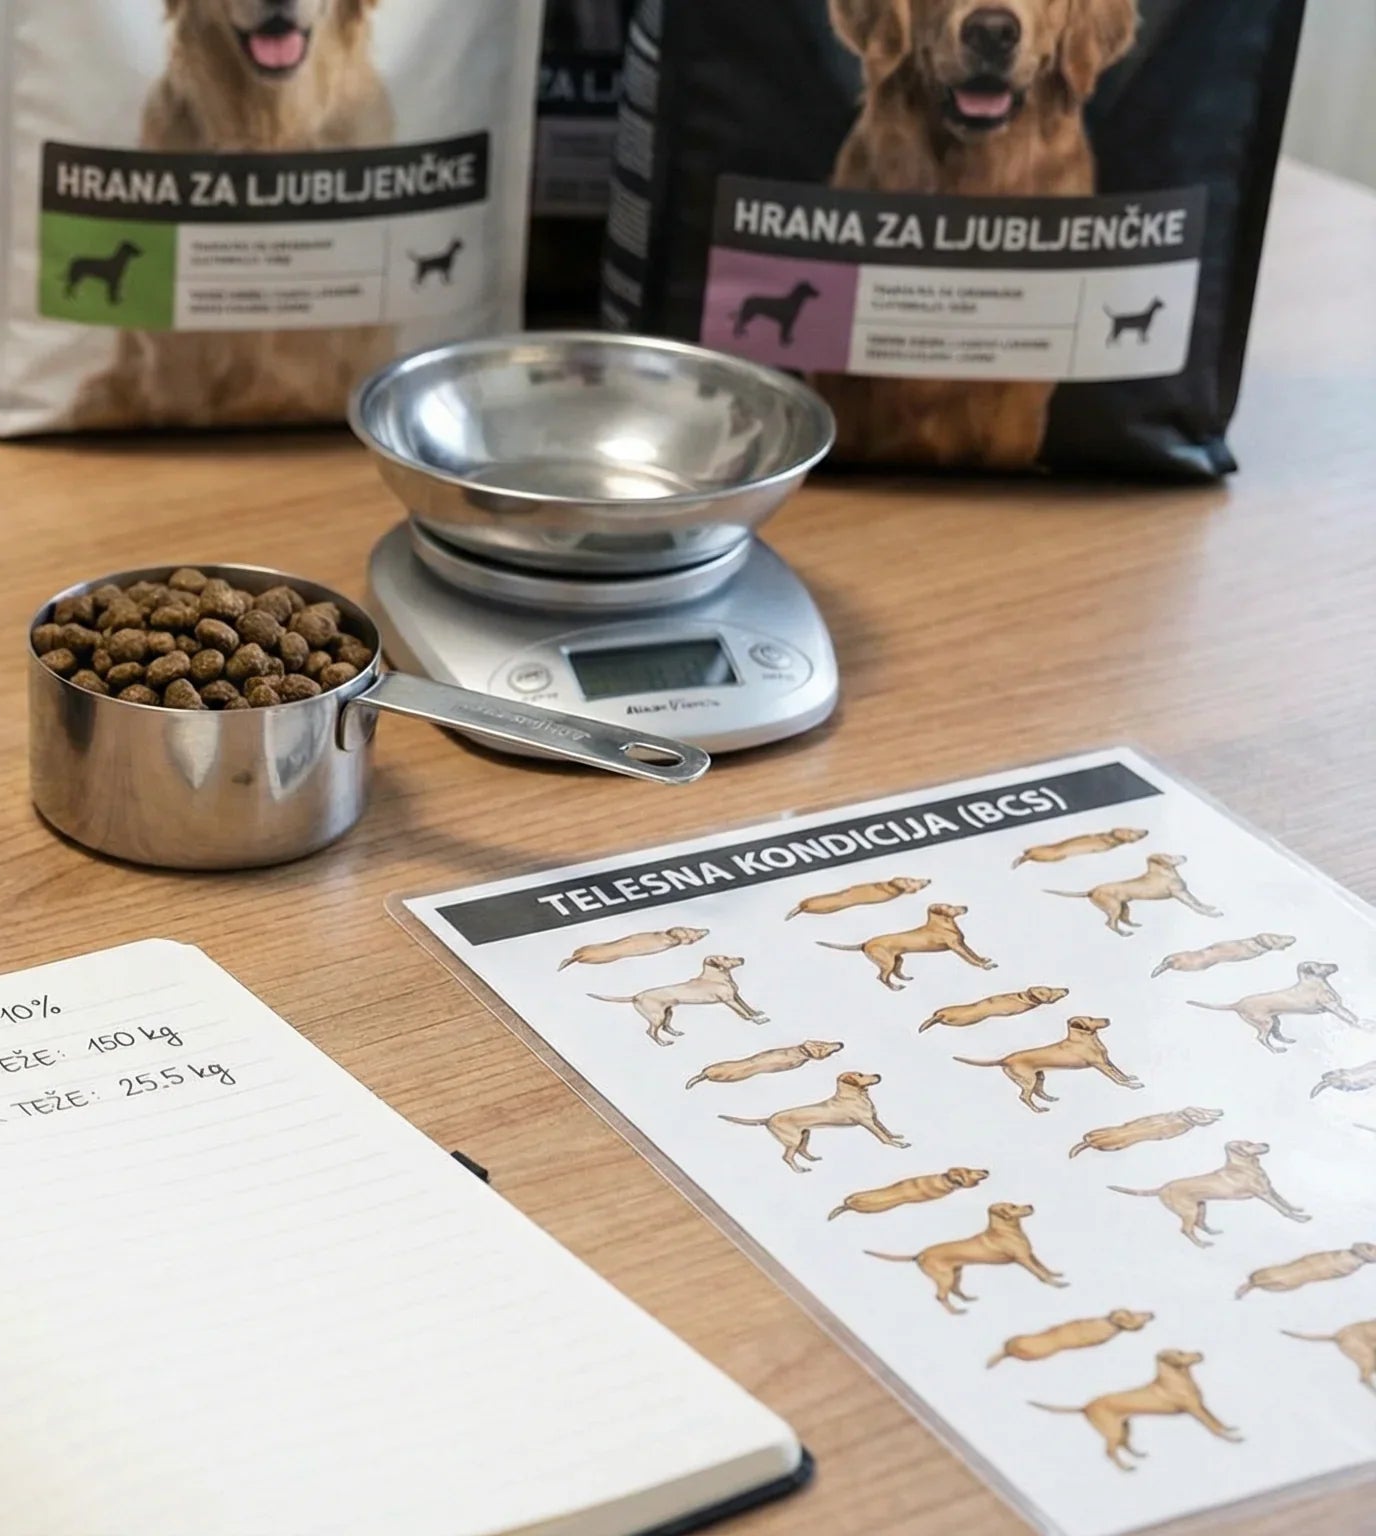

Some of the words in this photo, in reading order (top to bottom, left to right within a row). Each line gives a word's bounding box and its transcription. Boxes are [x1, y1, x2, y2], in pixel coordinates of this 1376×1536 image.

[56, 162, 181, 206] HRANA
[188, 172, 238, 206] ZA
[246, 153, 476, 207] LJUBLJENČKE
[733, 199, 865, 246] HRANA
[873, 213, 924, 248] ZA
[933, 206, 1187, 251] LJUBLJENČKE
[538, 861, 735, 917] TELESNA
[734, 811, 960, 875] KONDICIJA
[957, 786, 1068, 830] (BCS)
[87, 1030, 135, 1054] 150
[139, 1022, 183, 1049] kg
[12, 1086, 100, 1120] TEŽE:
[119, 1066, 184, 1098] 25.5
[189, 1060, 236, 1087] kg
